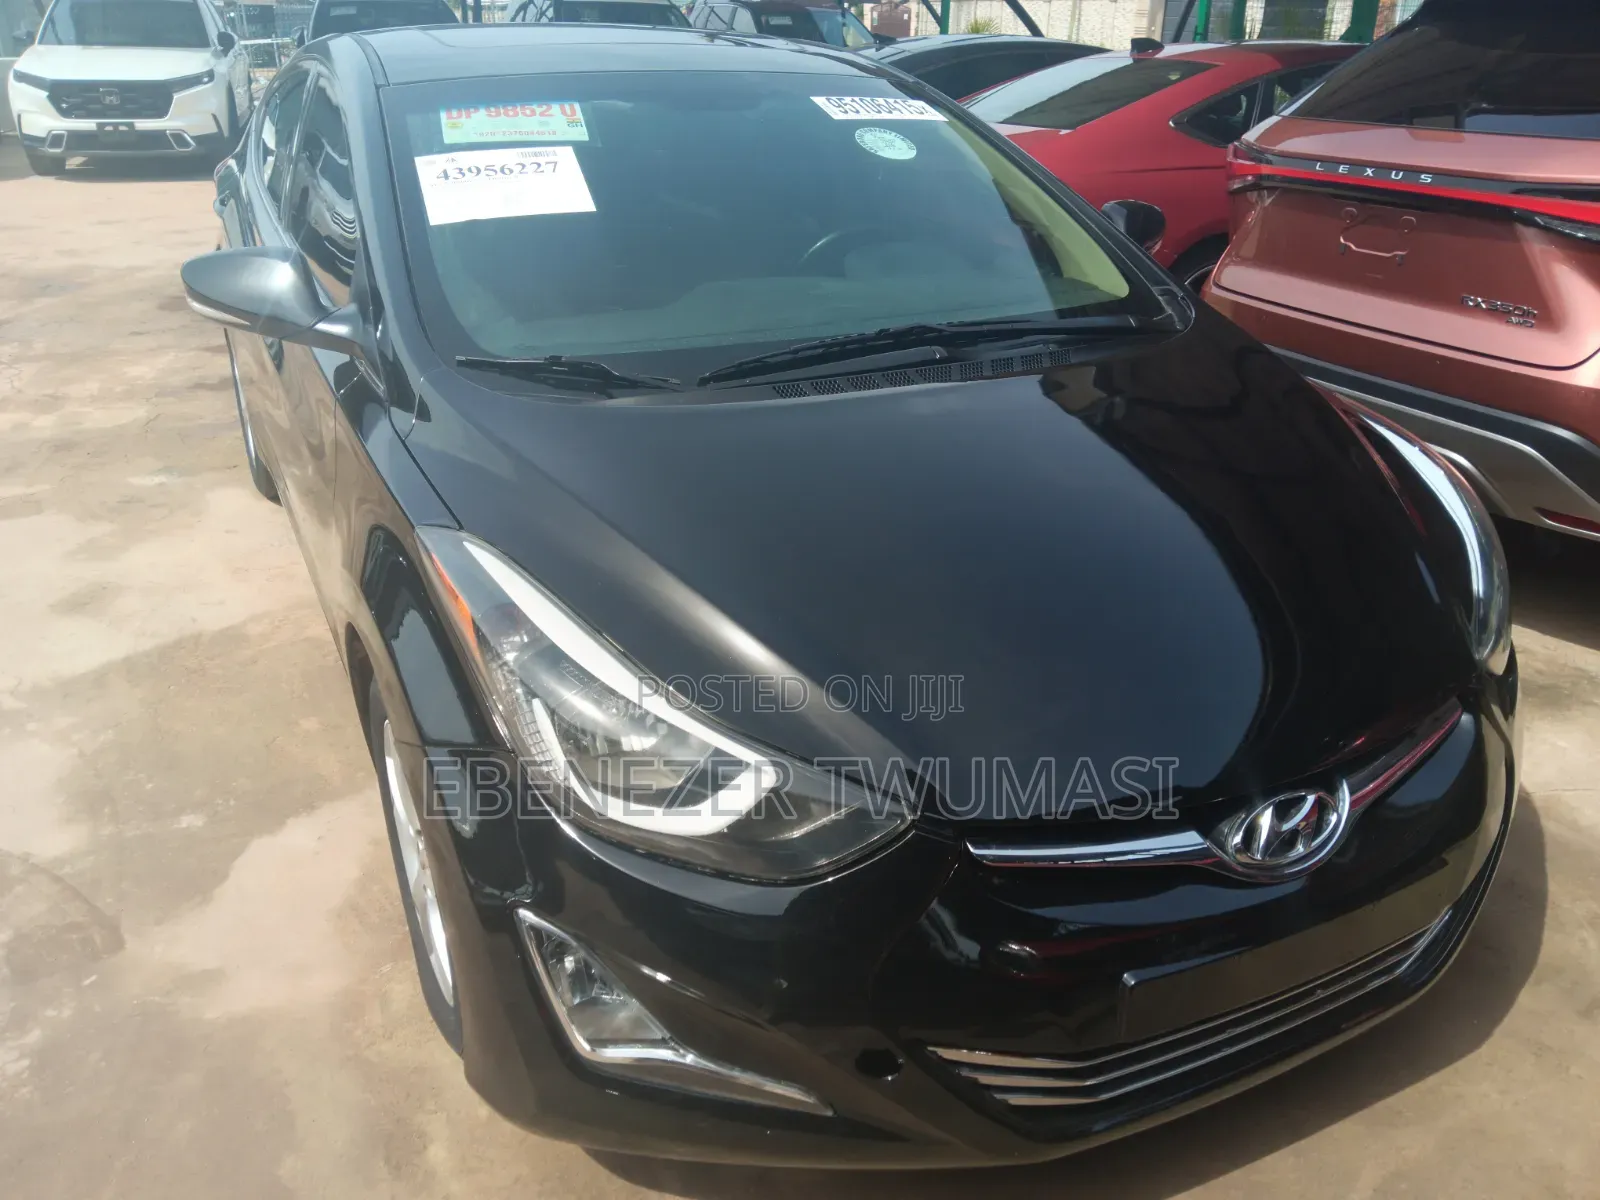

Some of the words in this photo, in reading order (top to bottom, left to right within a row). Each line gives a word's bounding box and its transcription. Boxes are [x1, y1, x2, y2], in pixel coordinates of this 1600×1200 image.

[484, 103, 556, 118] 9852
[558, 103, 577, 118] U
[436, 161, 559, 181] 43956227
[1315, 161, 1434, 184] LEXUS
[1461, 293, 1539, 318] RX350h
